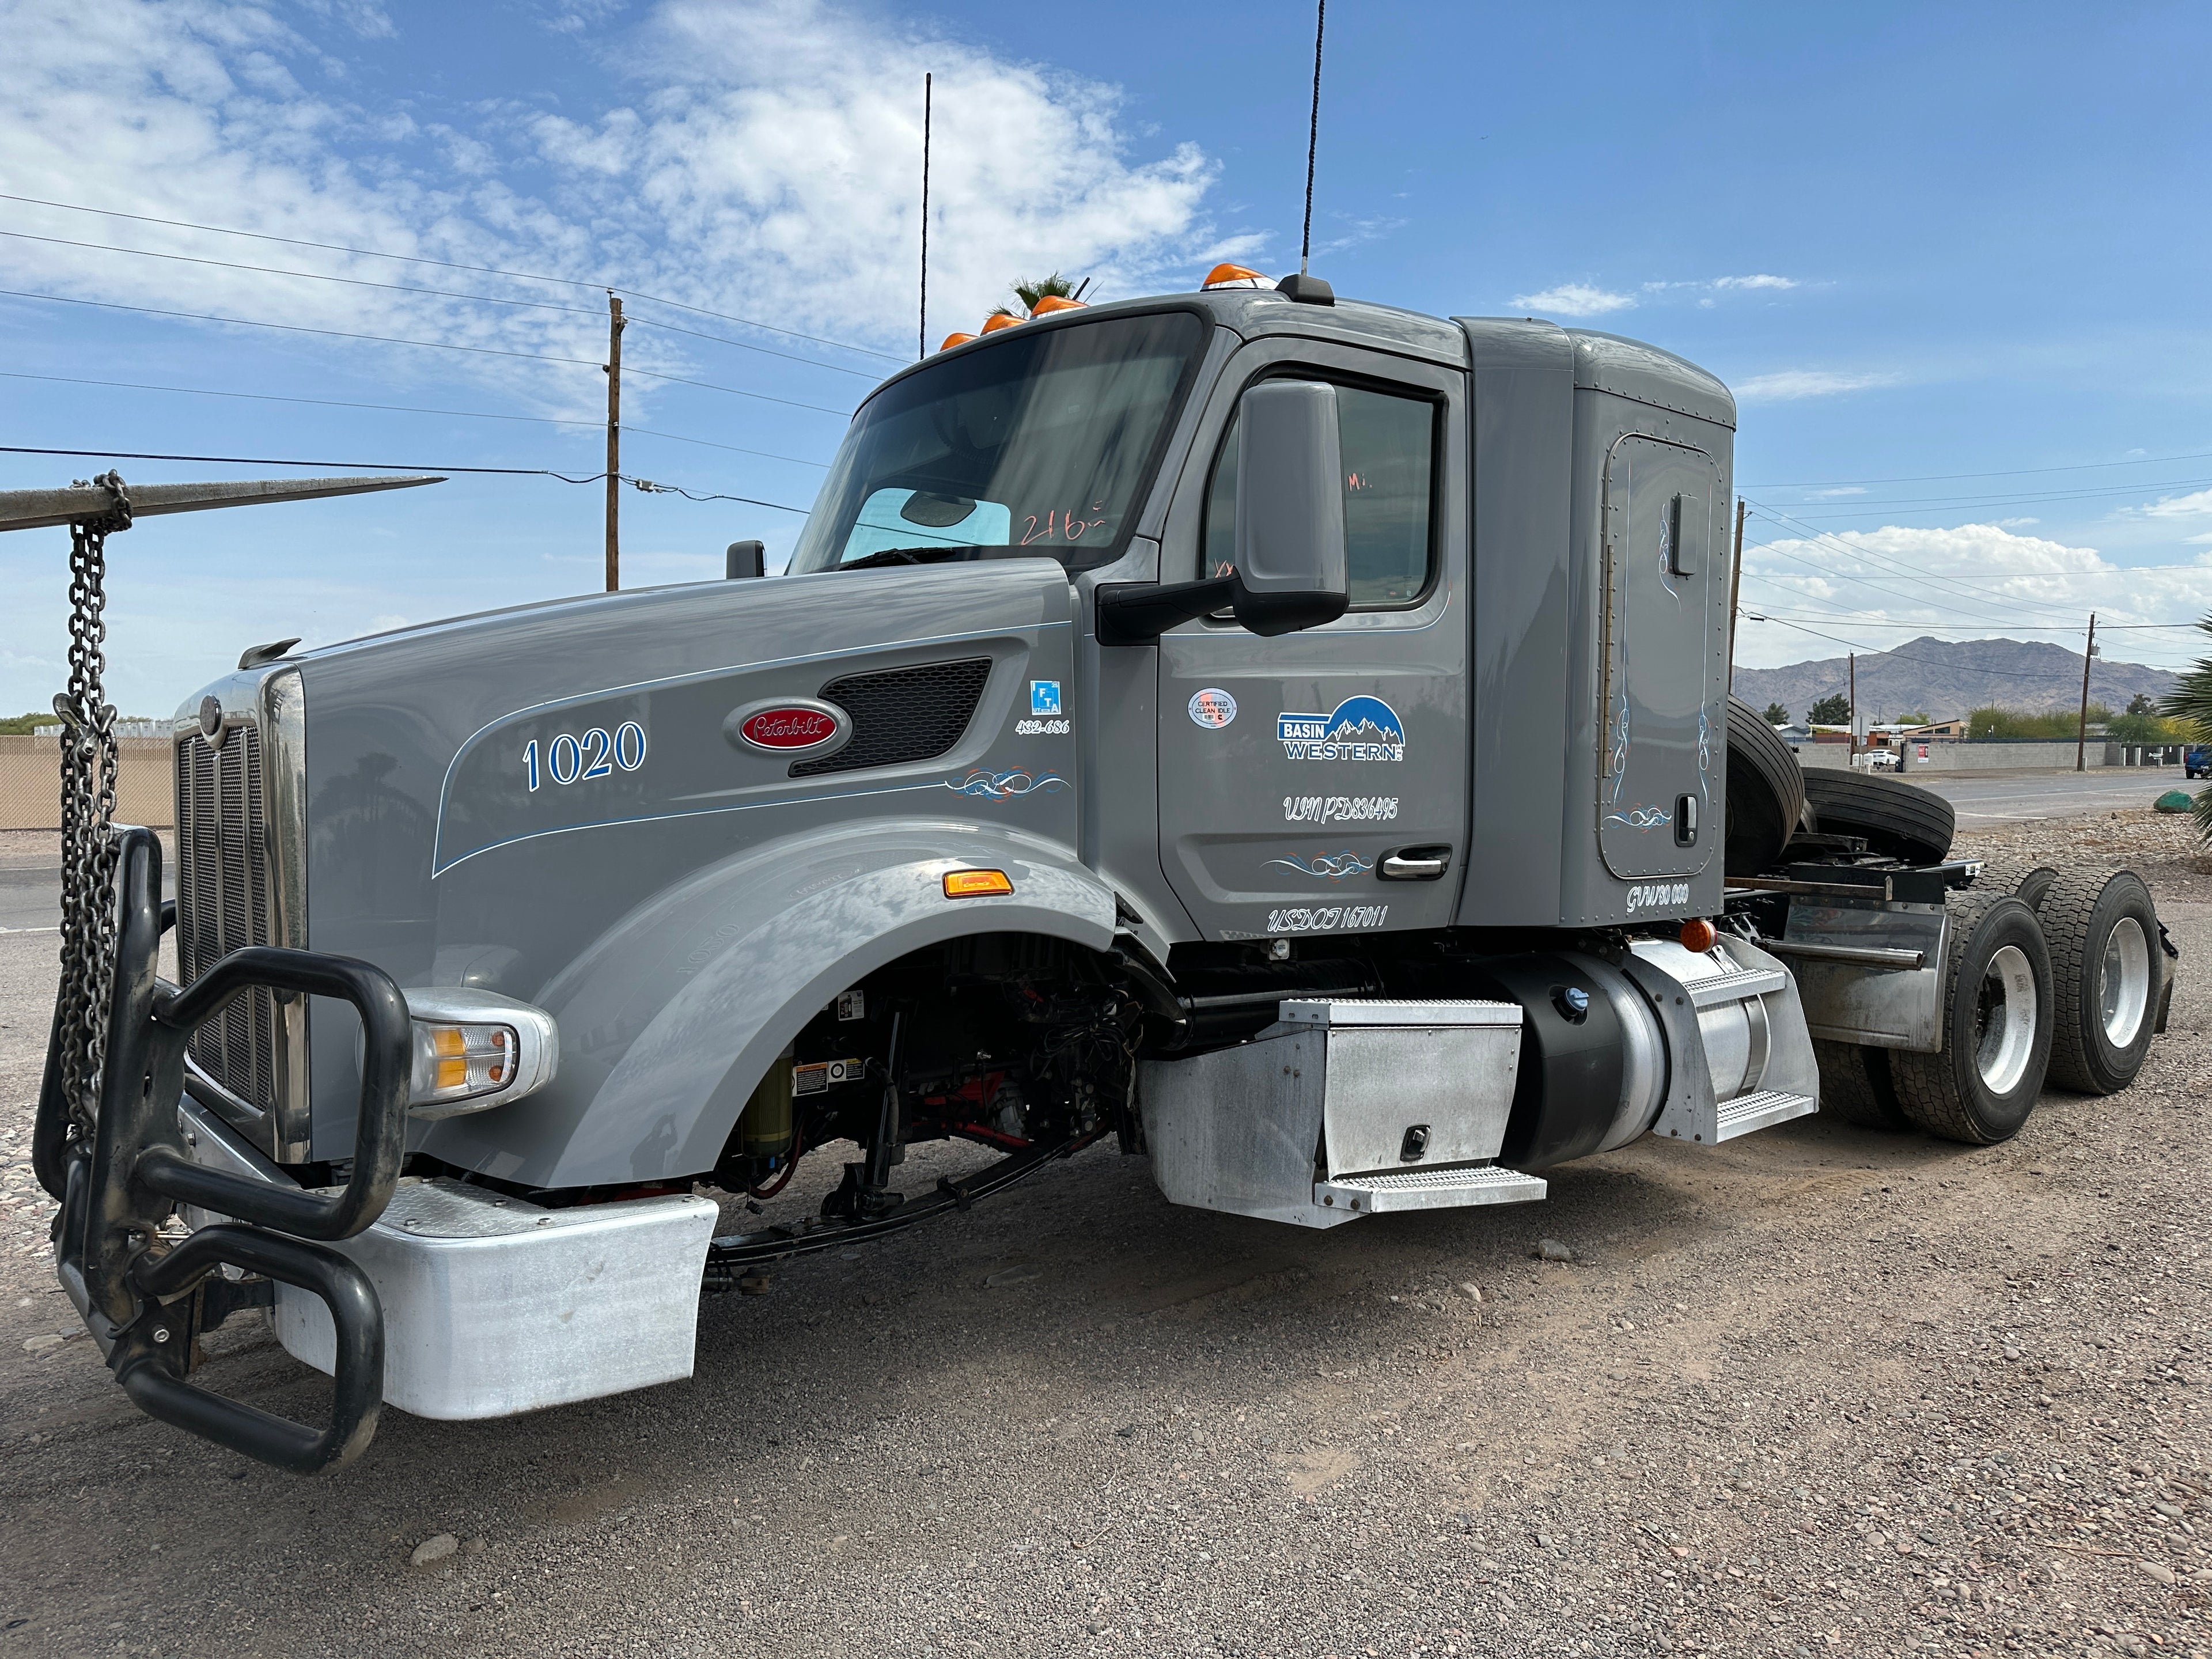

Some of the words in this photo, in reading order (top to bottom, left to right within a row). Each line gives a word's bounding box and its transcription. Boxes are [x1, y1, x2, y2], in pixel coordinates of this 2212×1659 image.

[753, 717, 828, 739] Peterbilt
[1015, 719, 1070, 735] 432-686
[1283, 723, 1324, 738] BASIN
[522, 721, 647, 792] 1020
[1283, 741, 1397, 762] WESTERN
[1267, 907, 1342, 933] USDOT
[1340, 905, 1388, 929] 167011
